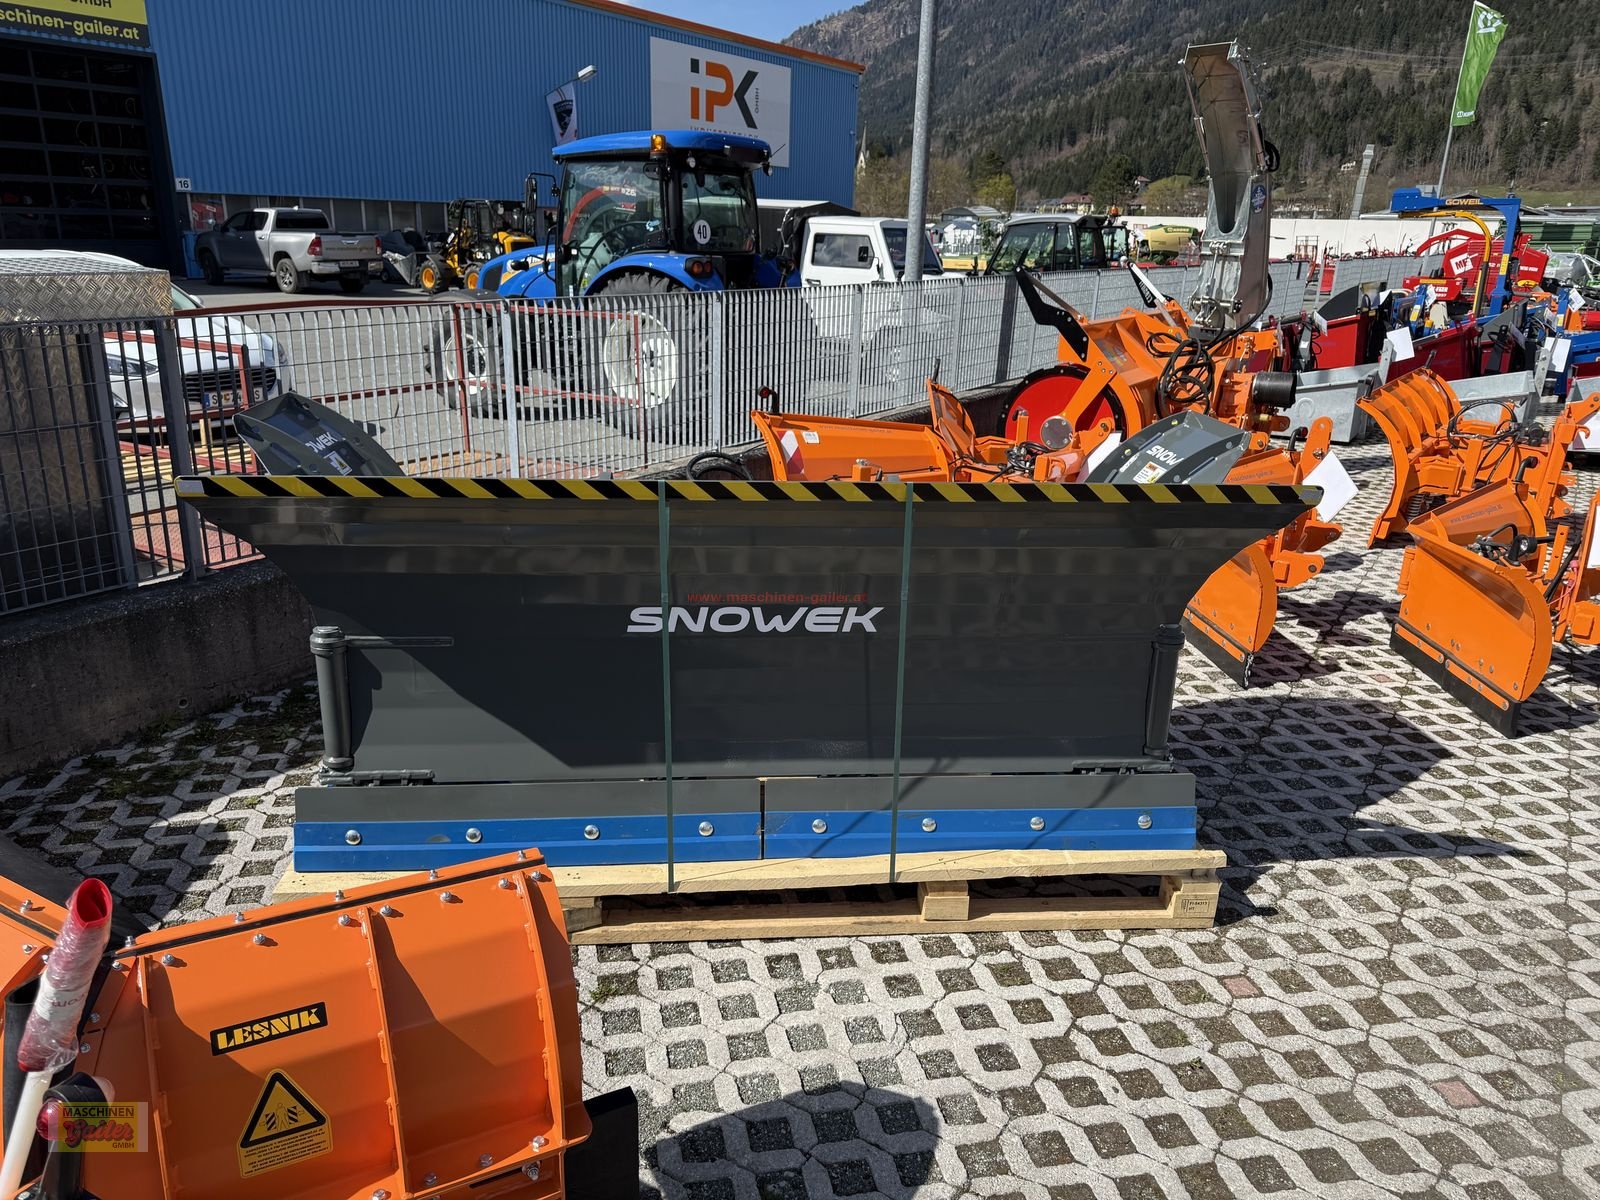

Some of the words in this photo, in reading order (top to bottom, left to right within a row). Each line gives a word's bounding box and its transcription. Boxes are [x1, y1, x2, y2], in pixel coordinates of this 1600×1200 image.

[70, 0, 112, 8] mbH
[178, 179, 189, 189] 16
[697, 224, 707, 239] 40
[1146, 445, 1185, 465] SNOW
[687, 591, 868, 605] www.maschinen-gailer.at
[626, 606, 884, 633] SNOWEK
[216, 1008, 321, 1050] LESNIK
